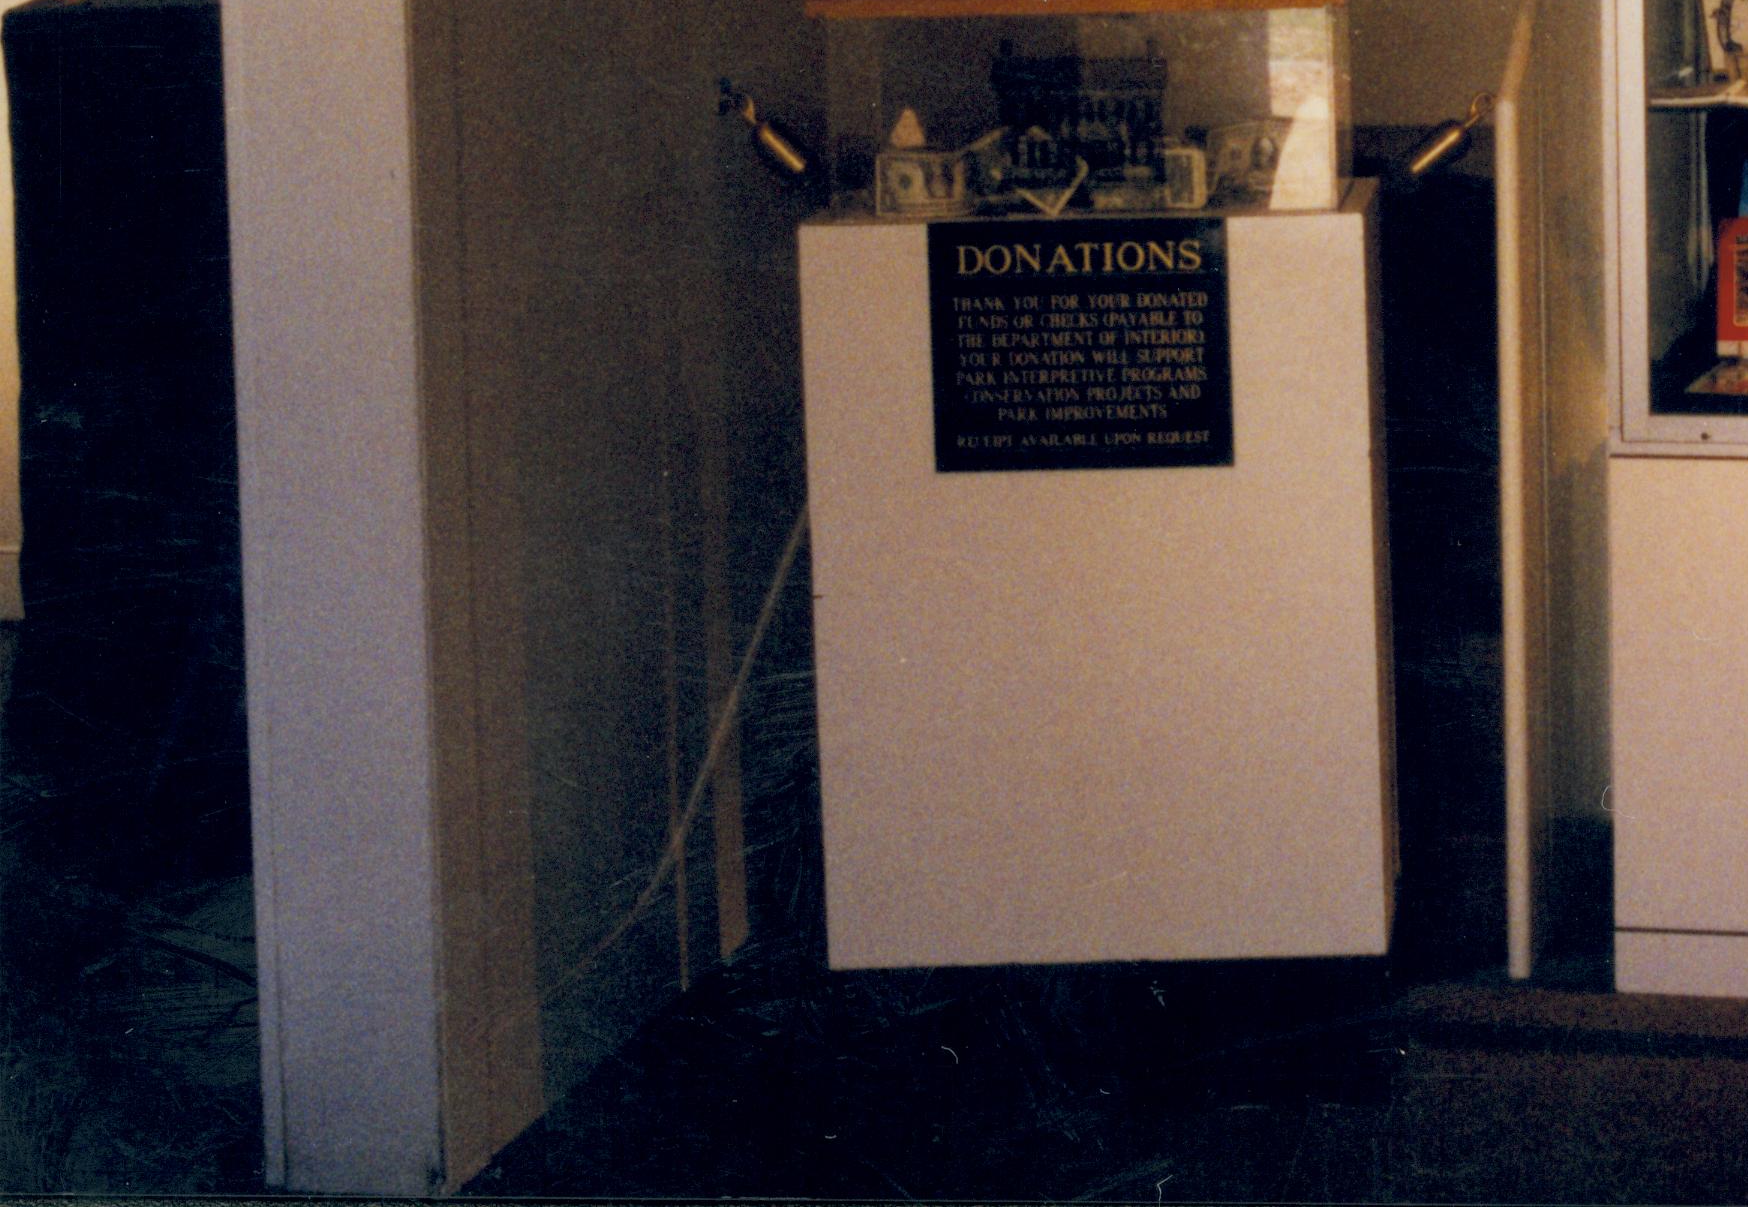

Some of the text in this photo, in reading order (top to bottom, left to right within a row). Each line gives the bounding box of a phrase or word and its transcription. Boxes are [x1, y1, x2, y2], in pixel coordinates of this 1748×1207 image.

[957, 240, 1201, 275] DONATIONS
[953, 292, 1208, 312] THANK YOU FOR YOUR DONATED
[958, 315, 1009, 329] FUNDS
[1013, 314, 1034, 329] OR
[1040, 313, 1098, 328] CHECKS
[1183, 310, 1203, 326] TO
[958, 333, 985, 348] THE
[991, 331, 1093, 348] DEPARTMENT
[1099, 331, 1115, 346] OF
[960, 347, 1204, 367] YOUR DONATION WILL SUPPORT
[956, 366, 1208, 386] PARK INTERPRETIVE PROGRAMS
[1086, 385, 1163, 401] PROJECTS
[1168, 383, 1202, 400] AND
[997, 403, 1168, 421] PARK IMPROVEMENTS
[1021, 433, 1098, 447] AVAILABLE
[1104, 431, 1141, 445] UPON
[1147, 429, 1210, 444] REQUEST
